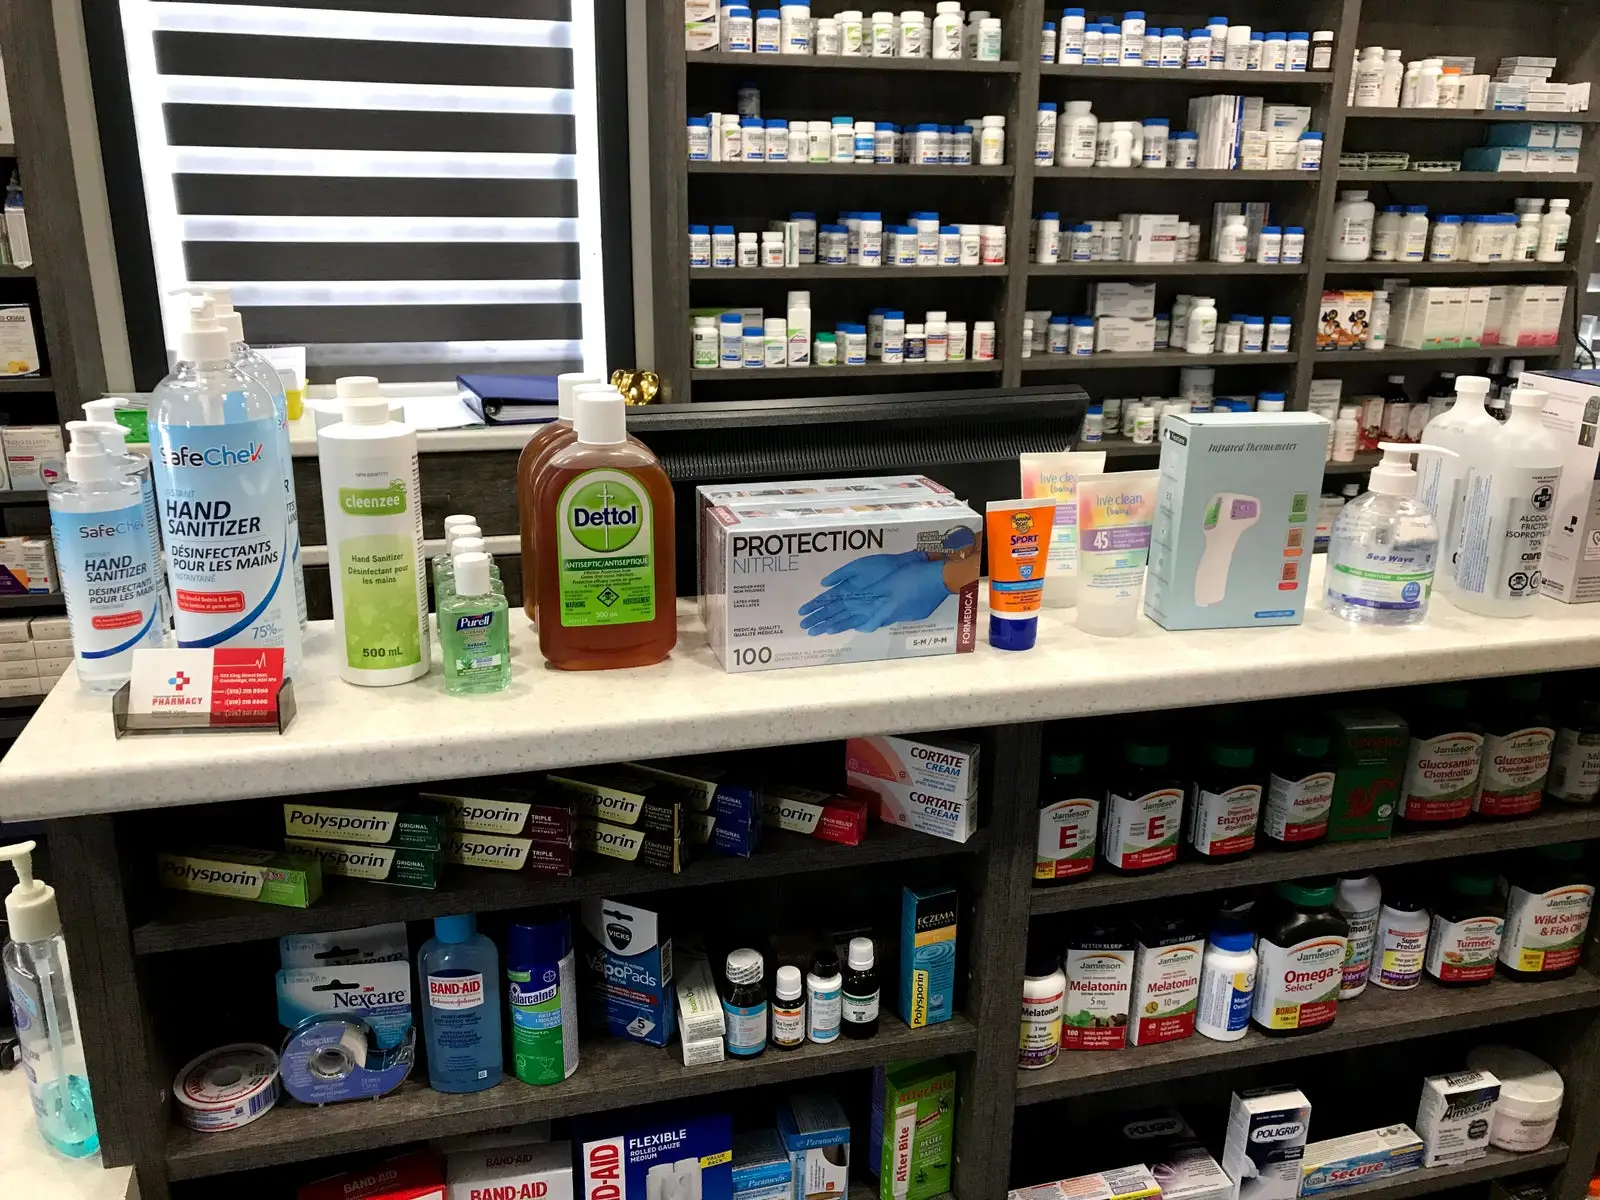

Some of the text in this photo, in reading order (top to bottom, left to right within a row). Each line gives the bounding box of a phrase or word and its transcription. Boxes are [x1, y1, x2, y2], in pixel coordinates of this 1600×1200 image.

[1208, 442, 1297, 453] Infrared Thermometer
[1040, 472, 1080, 484] live clea
[346, 494, 400, 508] cleenzee
[1096, 494, 1114, 506] live
[166, 499, 232, 520] HAND
[574, 506, 636, 527] Dettol
[168, 516, 261, 537] SANITIZER
[733, 528, 884, 557] PROTECTION
[1010, 535, 1039, 546] SPORT
[1093, 531, 1109, 548] 45
[172, 540, 271, 559] DÉSINFECTANTS
[174, 552, 278, 572] POUR LES MAINS
[352, 553, 404, 563] Hand Sanitizer
[1366, 552, 1386, 561] Sea
[1522, 552, 1542, 560] care
[85, 555, 132, 572] HAND
[565, 558, 648, 568] ANTISEPTIC/ANTISEPTIQUE
[733, 554, 799, 574] NITRILE
[86, 562, 147, 582] SANITIZER
[394, 565, 408, 574] pour
[362, 576, 396, 585] les mains
[90, 592, 134, 604] POUR LES
[460, 616, 490, 628] Purell
[962, 592, 973, 644] FORMEDICA
[252, 623, 278, 640] 75%
[362, 646, 403, 658] 500 mL
[734, 646, 772, 666] 100
[152, 698, 203, 706] PHARMACY
[1434, 744, 1474, 754] Jamieson
[1510, 740, 1547, 750] Jamieson
[910, 747, 962, 768] CORTATE
[926, 762, 960, 776] CREAM
[716, 794, 742, 804] ORIGINAL
[910, 792, 962, 813] CORTATE
[1143, 799, 1176, 811] Jamieson
[644, 804, 673, 815] COMPLETE
[924, 806, 959, 822] CREAM
[1052, 809, 1089, 820] Jamieson
[290, 810, 388, 831] Polysporin
[531, 814, 552, 822] TRIPLE
[836, 819, 853, 828] RELIEF
[399, 822, 428, 830] ORIGINAL
[1148, 815, 1166, 840] E
[716, 828, 740, 838] ORIGINAL
[1058, 825, 1078, 850] E
[644, 840, 672, 851] COMPLETE
[396, 860, 424, 868] ORIGINAL
[162, 861, 258, 886] Polysporin
[1547, 896, 1586, 908] Jamieson
[918, 910, 954, 926] ECZEMA
[1534, 914, 1556, 925] Wild
[1464, 924, 1495, 932] Jamieson
[1540, 928, 1549, 936] &
[1550, 925, 1569, 935] Fish
[608, 929, 630, 941] VICKS
[1179, 934, 1196, 942] SLEEP
[1456, 939, 1496, 948] Turmeric
[1158, 954, 1194, 966] Jamieson
[1297, 948, 1340, 962] Jamieson
[587, 953, 657, 987] VapoPads
[1080, 961, 1120, 970] Jamieson
[1284, 962, 1342, 983] Omega-3
[430, 980, 480, 994] BAND-AID
[1070, 981, 1127, 992] Melatonin
[1146, 976, 1198, 993] Melatonin
[1285, 983, 1313, 992] Select
[333, 990, 405, 1008] Nexcare
[914, 973, 924, 1024] Polysporin
[1090, 998, 1095, 1006] 5
[1022, 1006, 1058, 1017] Melatonin
[1276, 1006, 1298, 1015] BONUS
[637, 1018, 646, 1029] 5
[301, 1038, 333, 1048] Nexcare
[1446, 1072, 1483, 1087] Amosan
[1440, 1100, 1492, 1122] Amosan
[1128, 1120, 1177, 1136] POLIGRIP
[1256, 1126, 1300, 1138] POLIGRIP
[629, 1129, 687, 1150] FLEXIBLE
[630, 1142, 680, 1157] ROLLED GAUZE
[897, 1126, 909, 1182] After Bite
[486, 1154, 533, 1168] BAND-AID
[630, 1152, 657, 1164] MEDIUM
[708, 1158, 722, 1166] PACK
[1330, 1162, 1384, 1181] Secure
[344, 1170, 397, 1194] BAND-AID
[470, 1182, 548, 1200] BAND-AID
